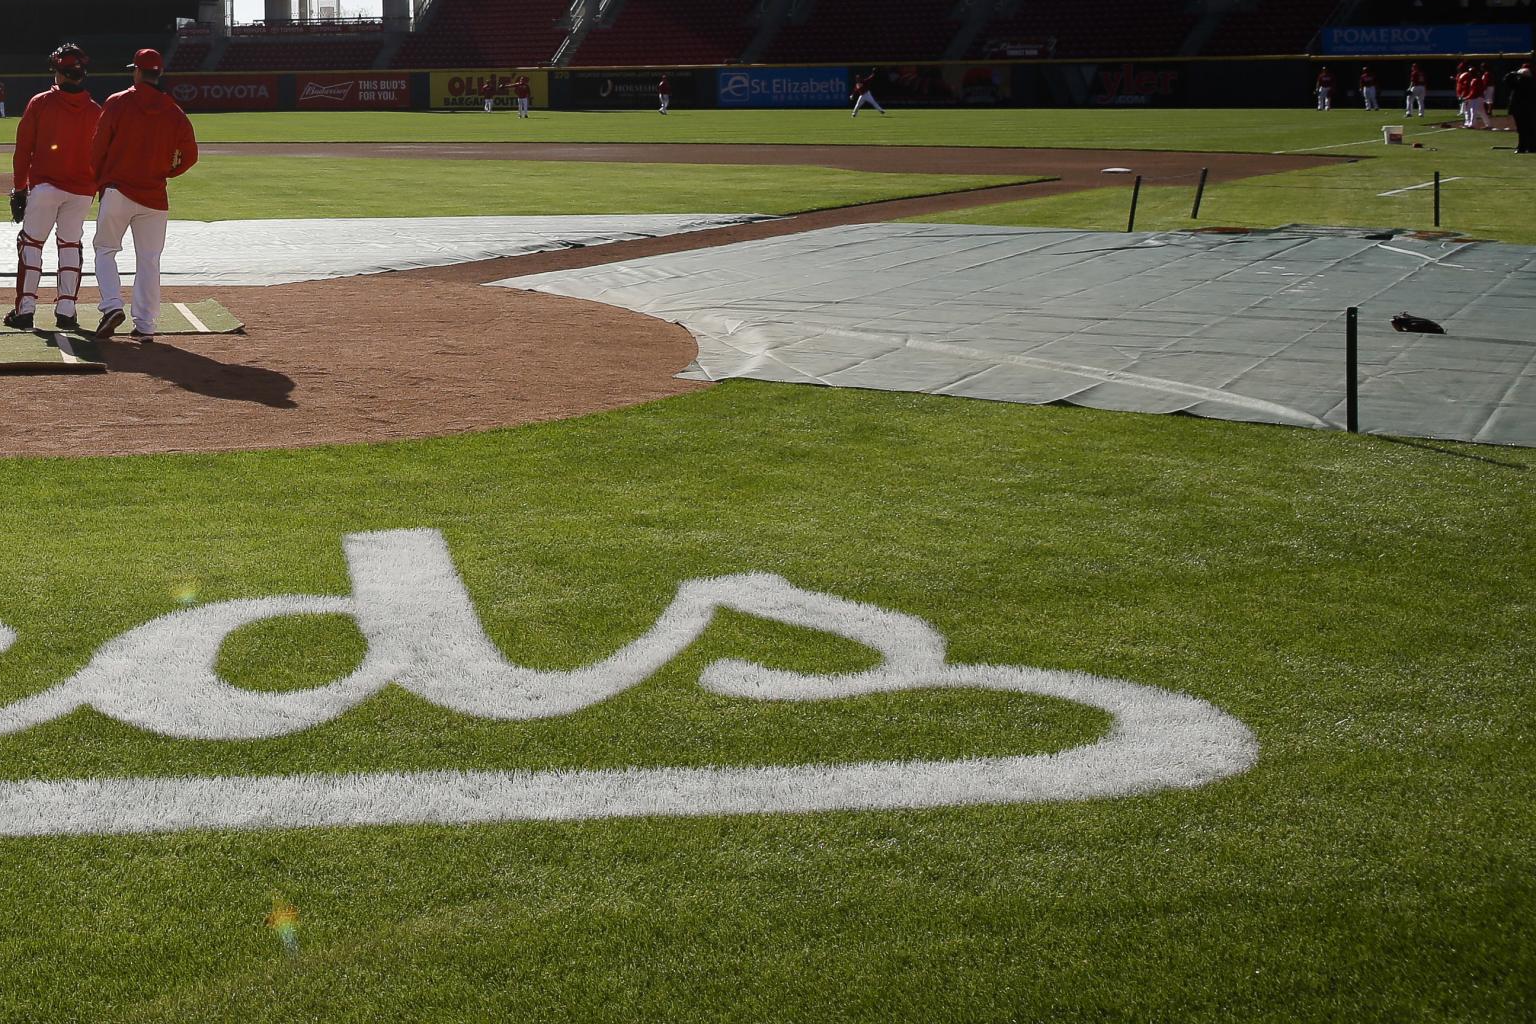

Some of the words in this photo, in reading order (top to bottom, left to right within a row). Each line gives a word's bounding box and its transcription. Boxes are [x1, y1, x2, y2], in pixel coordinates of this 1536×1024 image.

[1332, 27, 1433, 44] POMEROY
[358, 80, 379, 90] THIS
[380, 80, 407, 90] BUD'S
[447, 74, 519, 97] OLLIE'
[615, 83, 658, 93] HORSESH
[772, 77, 846, 94] Elizabeth
[201, 85, 270, 99] TOYOTA
[358, 91, 376, 101] FOR
[378, 90, 399, 101] YOU.
[444, 97, 486, 106] BARGAI
[494, 97, 534, 106] OUTT
